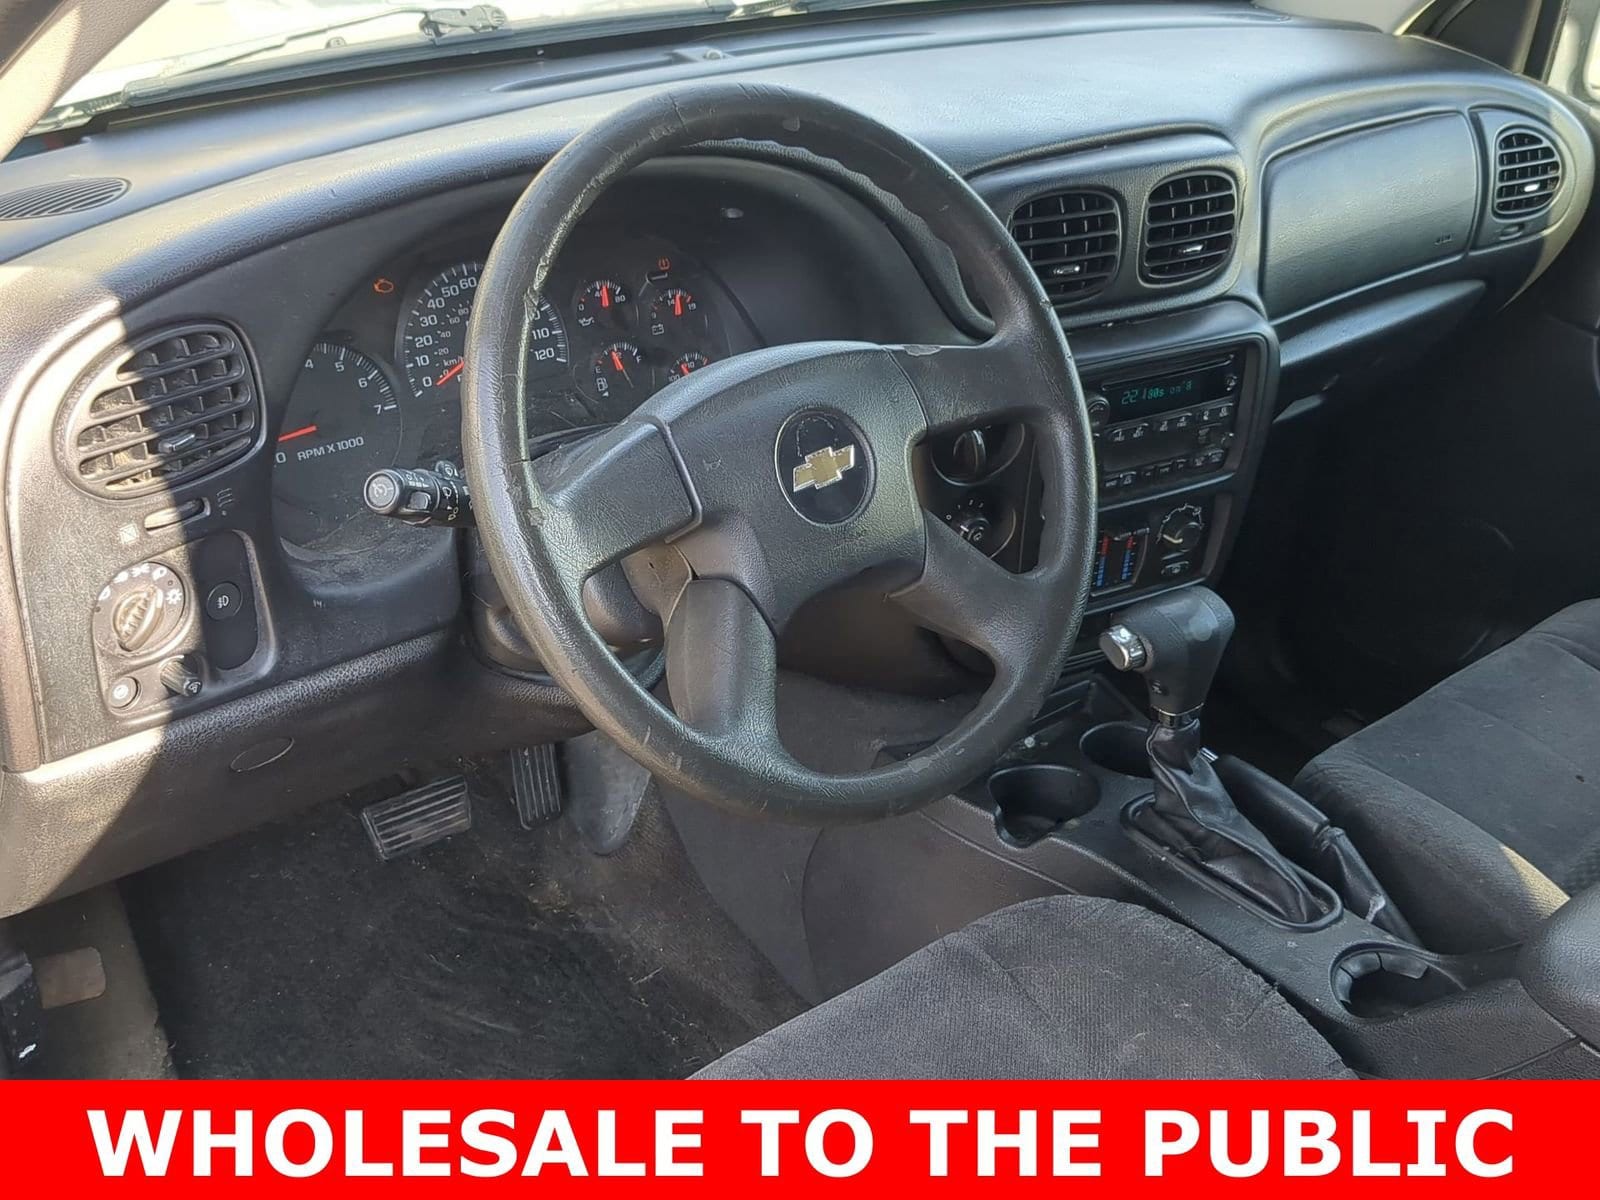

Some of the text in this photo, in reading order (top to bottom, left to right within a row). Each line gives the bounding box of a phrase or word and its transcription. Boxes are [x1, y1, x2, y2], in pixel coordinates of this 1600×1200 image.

[460, 277, 477, 290] 60
[441, 285, 460, 298] 50
[427, 298, 445, 309] 40
[420, 315, 438, 327] 30
[532, 327, 550, 340] 110
[414, 335, 433, 348] 20
[438, 347, 449, 355] 20
[534, 347, 555, 361] 120
[304, 359, 314, 369] 4
[334, 361, 345, 372] 5
[414, 355, 430, 366] 10
[358, 377, 368, 388] 6
[422, 376, 433, 388] 0
[373, 404, 382, 415] 7
[296, 436, 365, 461] RPM X 1000
[275, 451, 287, 463] 0
